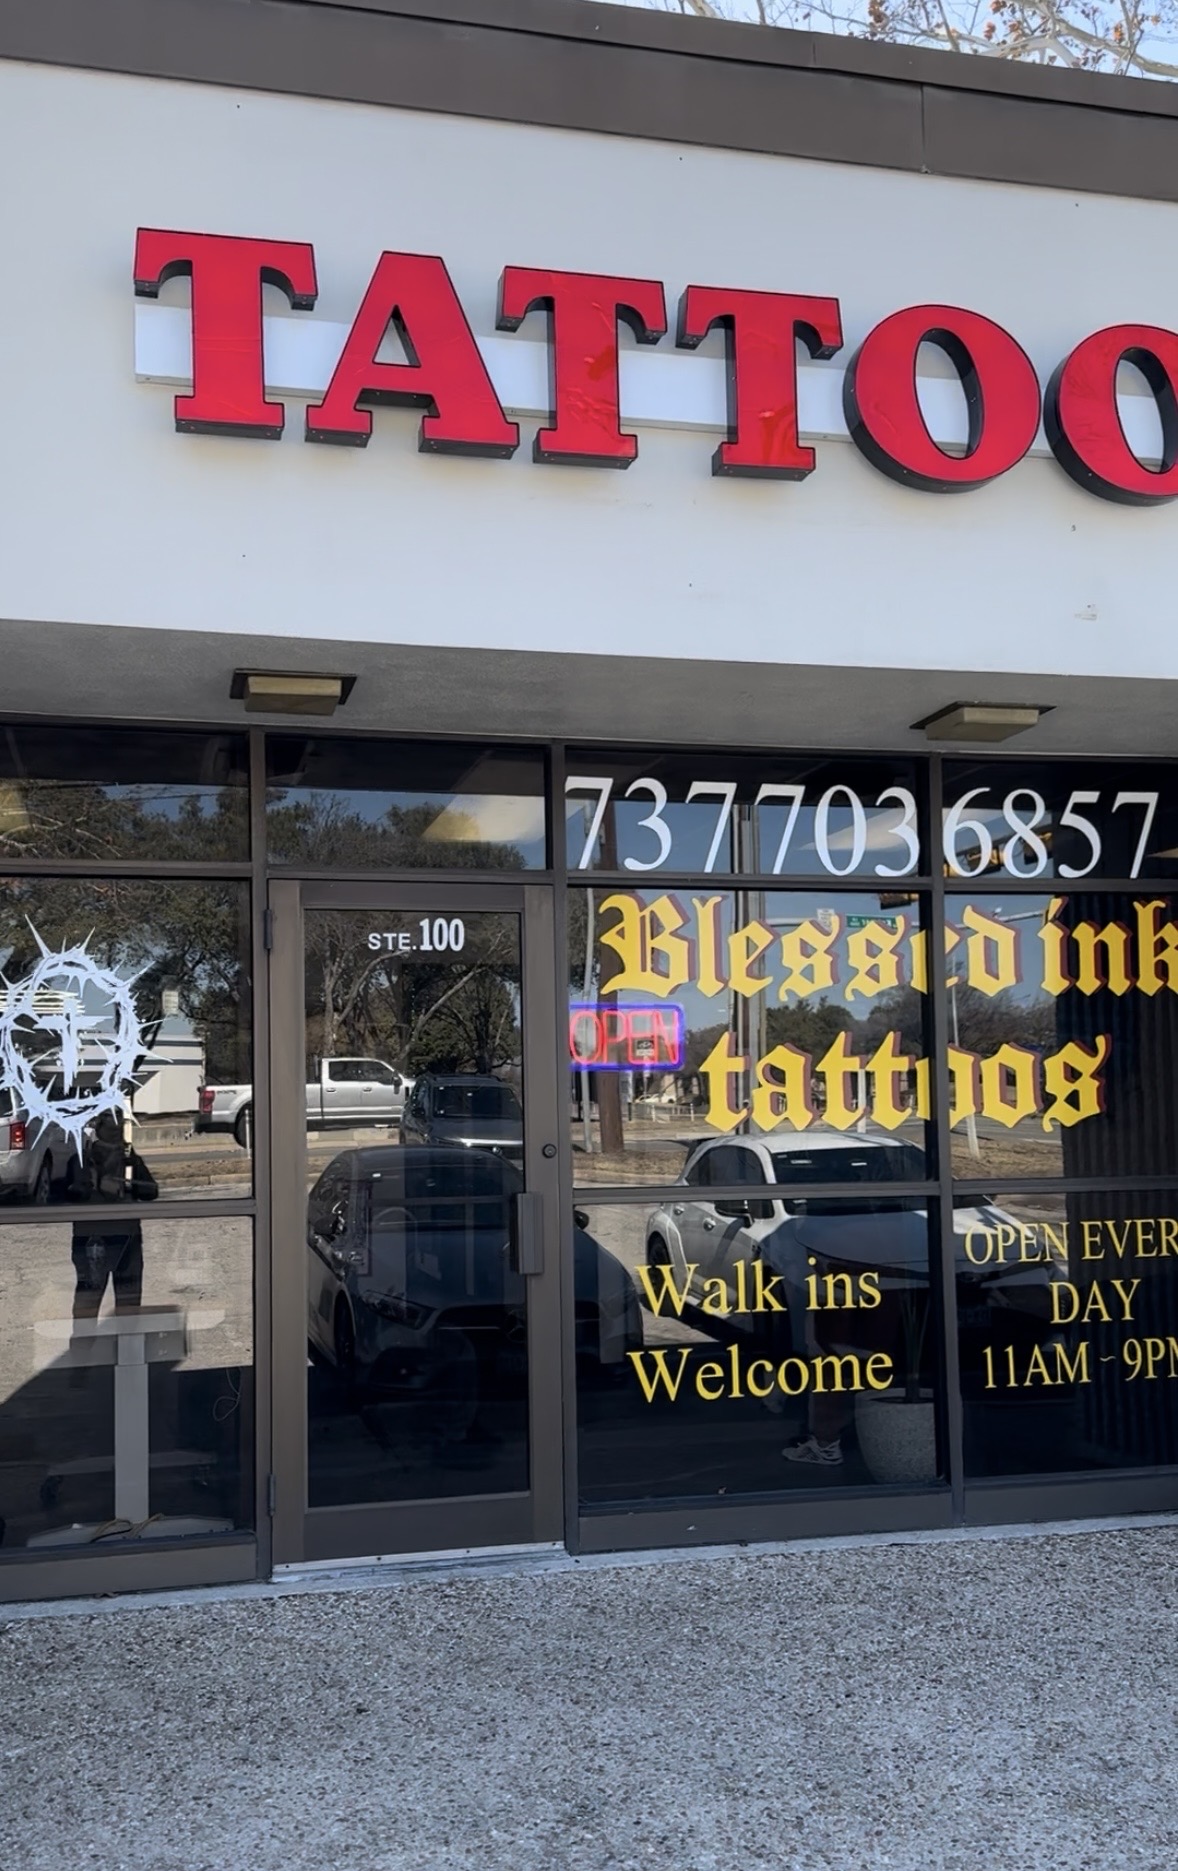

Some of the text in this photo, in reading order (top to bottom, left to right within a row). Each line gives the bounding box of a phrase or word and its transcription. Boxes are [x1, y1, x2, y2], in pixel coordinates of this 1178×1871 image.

[134, 227, 1178, 505] TATTOO
[943, 787, 1159, 878] 6857
[599, 893, 1178, 1001] Blessed ink
[569, 1010, 679, 1065] OPEN
[699, 1030, 1110, 1133] tattoos
[964, 1222, 1070, 1264] OPEN
[635, 1256, 882, 1319] Walk ins
[1049, 1278, 1142, 1325] DAY
[627, 1342, 894, 1403] Welcome
[983, 1340, 1093, 1390] 11AM
[1122, 1335, 1178, 1382] 9P
